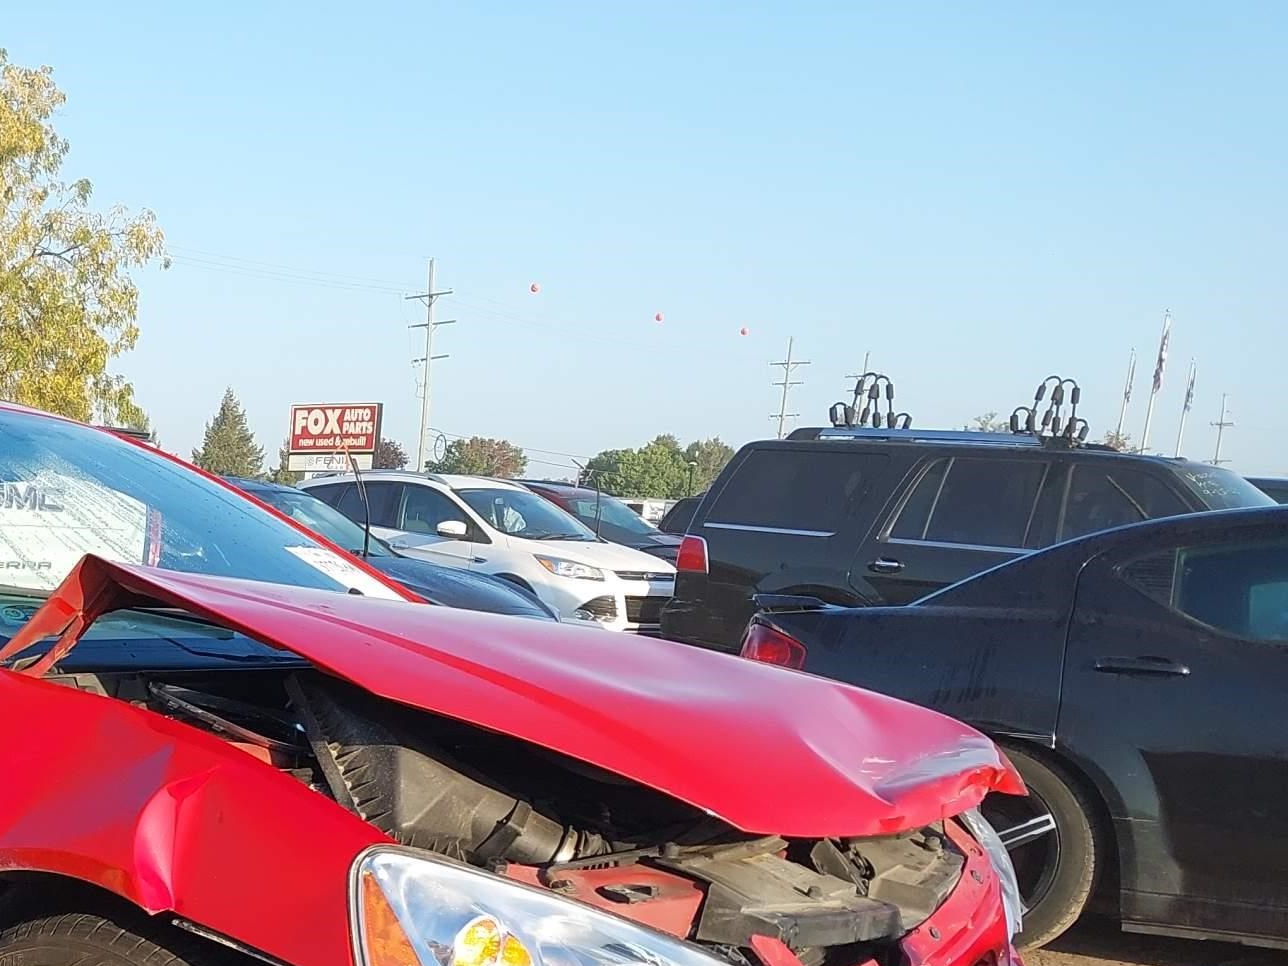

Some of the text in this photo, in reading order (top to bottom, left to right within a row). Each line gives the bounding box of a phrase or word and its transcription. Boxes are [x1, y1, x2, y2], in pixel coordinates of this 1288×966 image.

[294, 408, 343, 435] FOX
[343, 408, 372, 422] AUTO
[342, 421, 373, 435] PARTS
[298, 437, 314, 447] new
[315, 435, 334, 447] used
